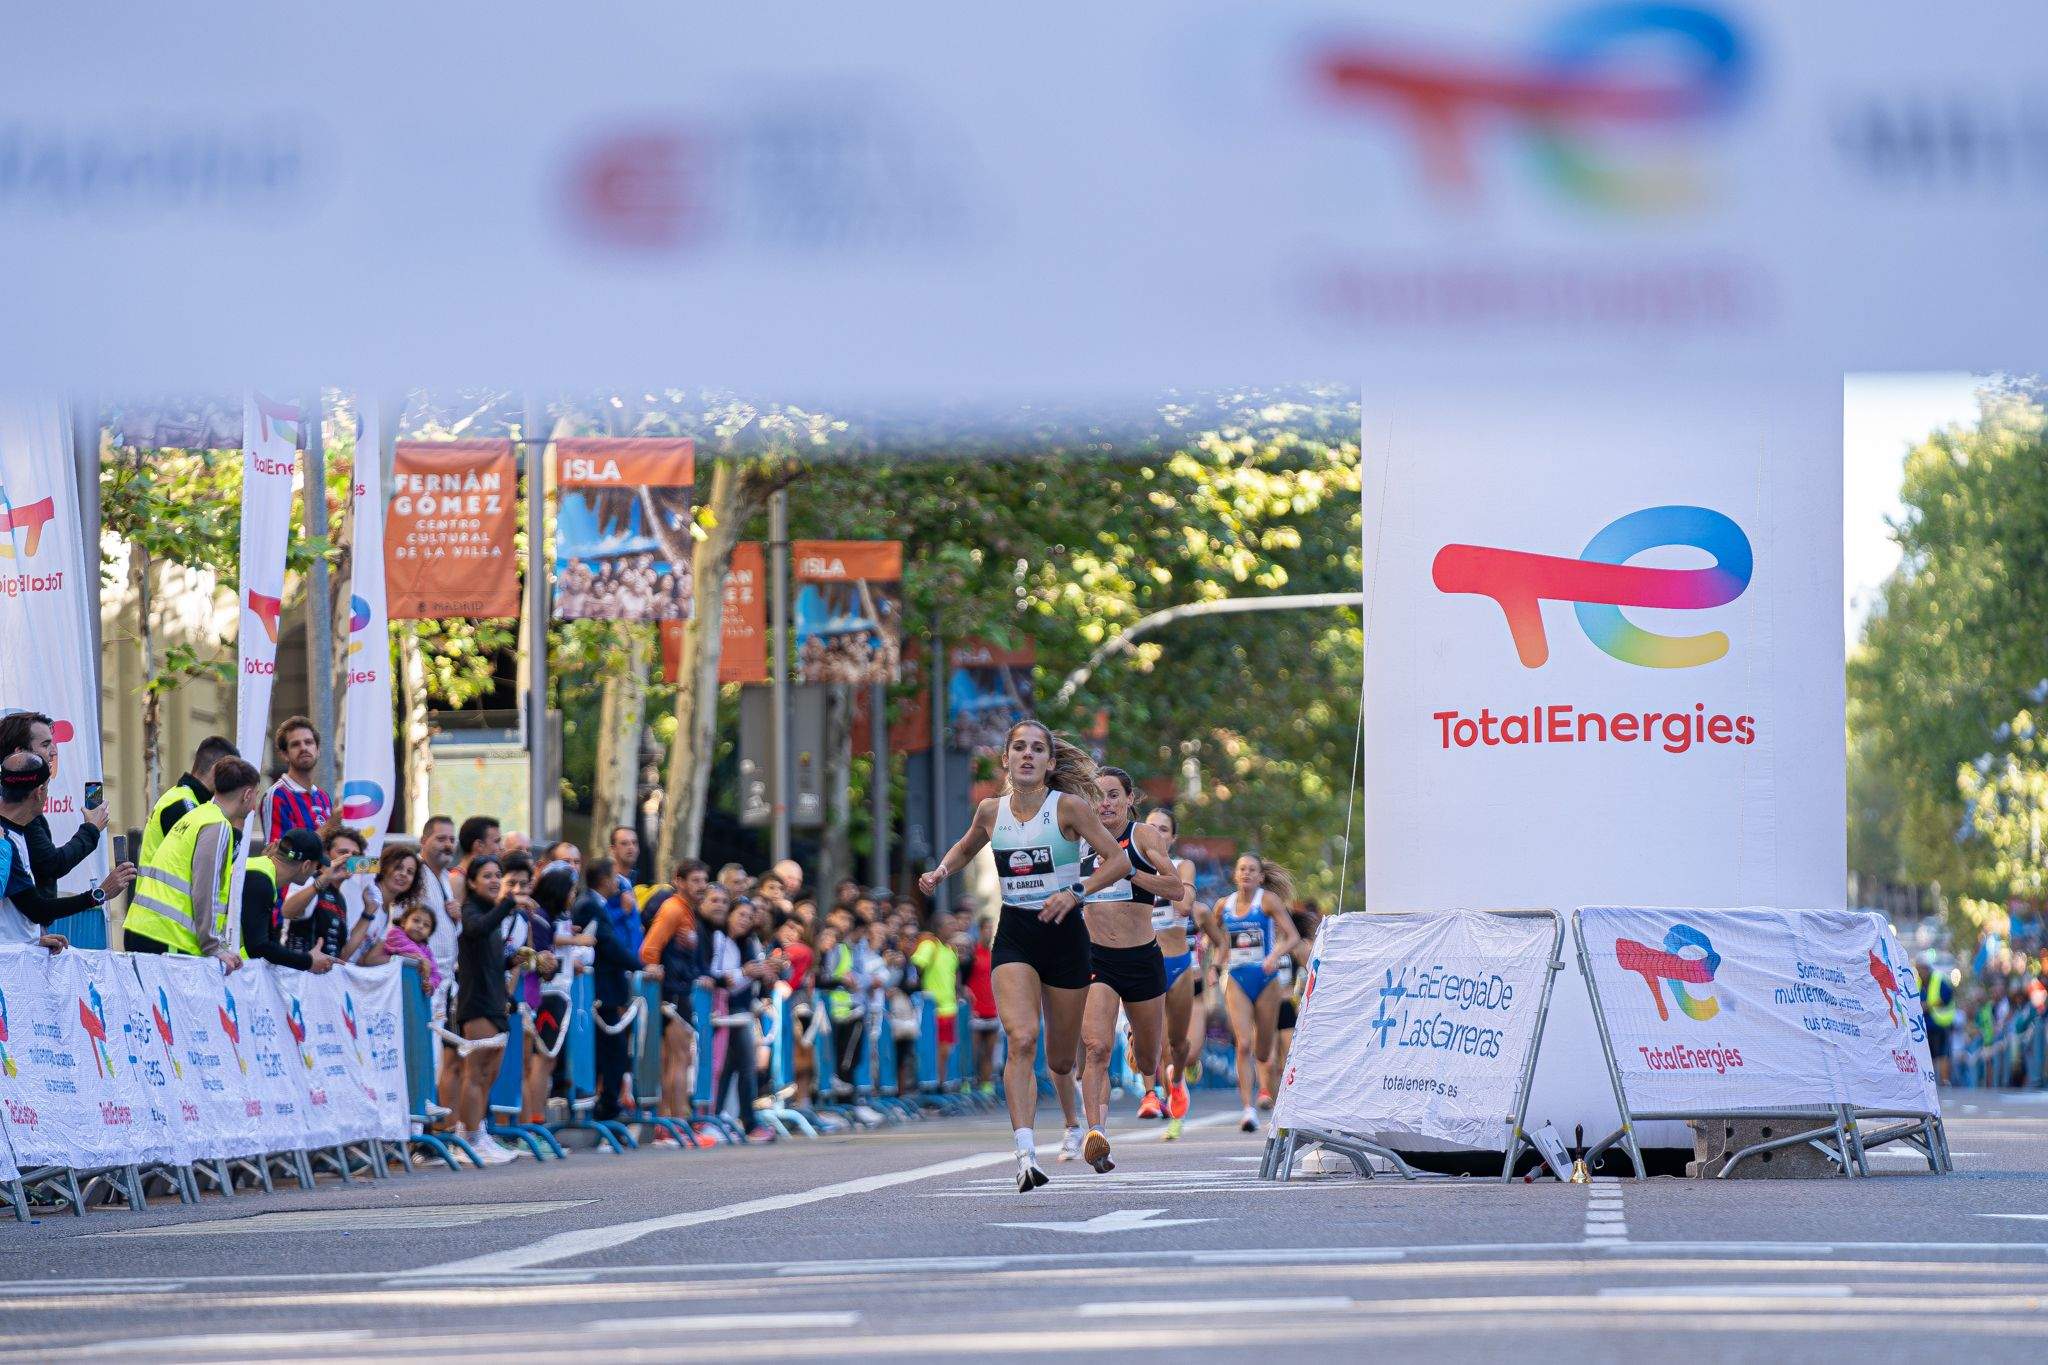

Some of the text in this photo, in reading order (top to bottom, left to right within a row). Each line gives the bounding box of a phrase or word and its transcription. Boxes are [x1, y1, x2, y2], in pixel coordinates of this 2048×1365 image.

[563, 459, 622, 480] ISLA
[394, 468, 501, 493] FERNÁN
[394, 492, 502, 516] GÓMEZ
[415, 519, 481, 531] CENTRO
[406, 533, 490, 545] CULTURAL
[395, 546, 417, 560] DE
[452, 546, 502, 558] VILLA
[1433, 703, 1755, 754] TotalEnergies
[1032, 849, 1050, 863] 25
[1638, 1042, 1744, 1075] TotalEnergies
